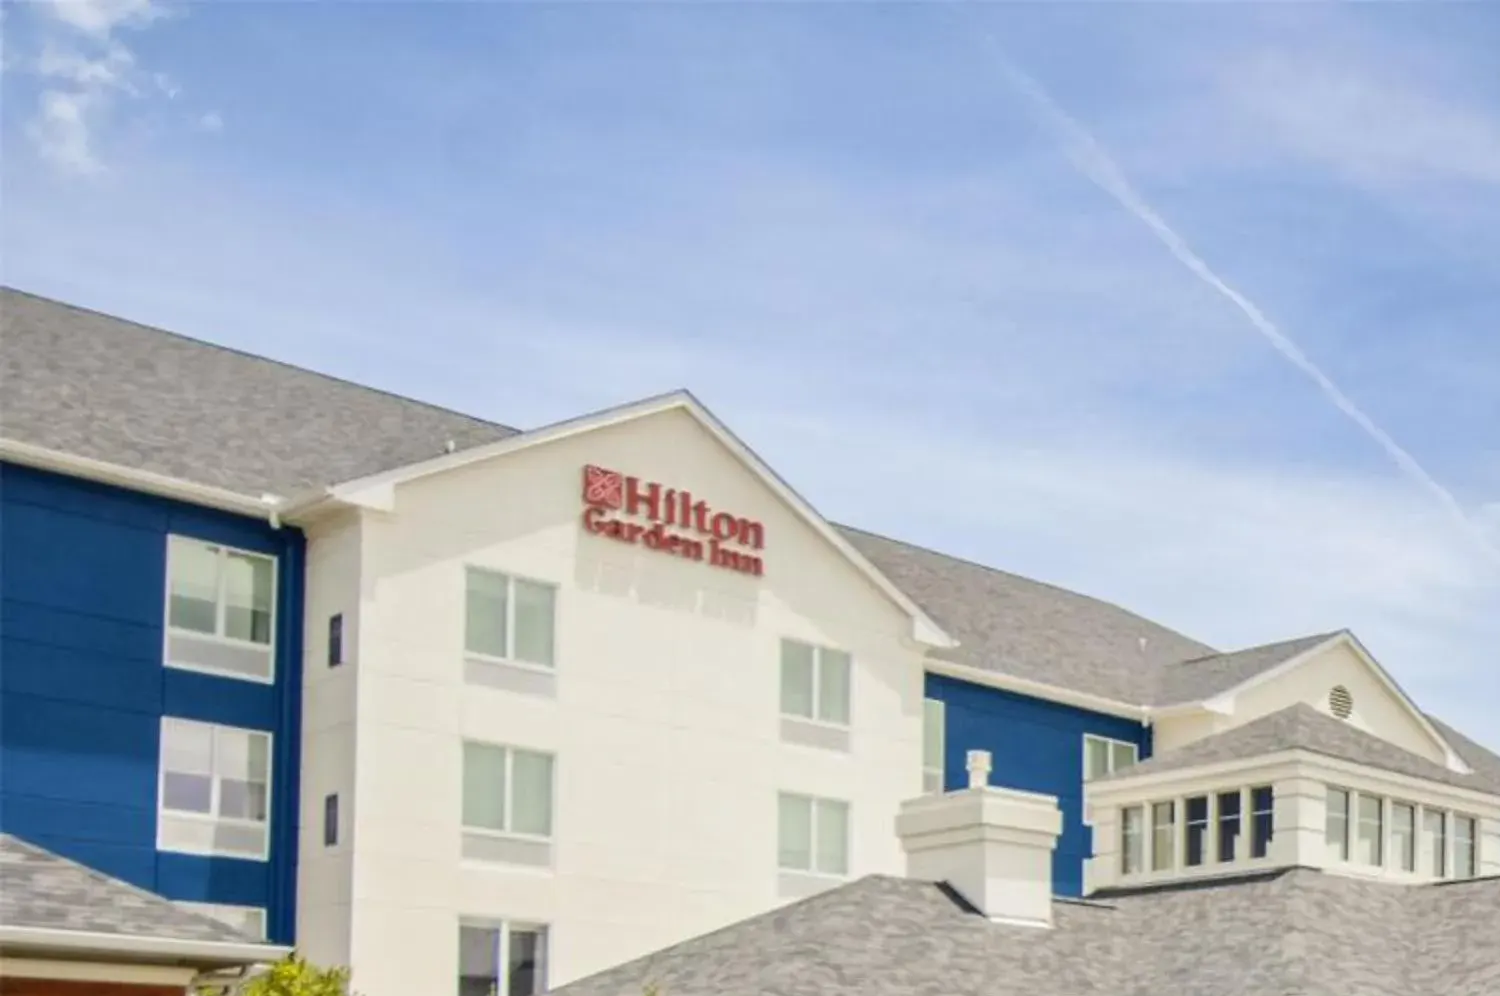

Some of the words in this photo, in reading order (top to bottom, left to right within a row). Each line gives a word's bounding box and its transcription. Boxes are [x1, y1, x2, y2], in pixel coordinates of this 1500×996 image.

[583, 507, 703, 561] Garden
[708, 538, 764, 576] Inn
[625, 476, 765, 549] Hilton
